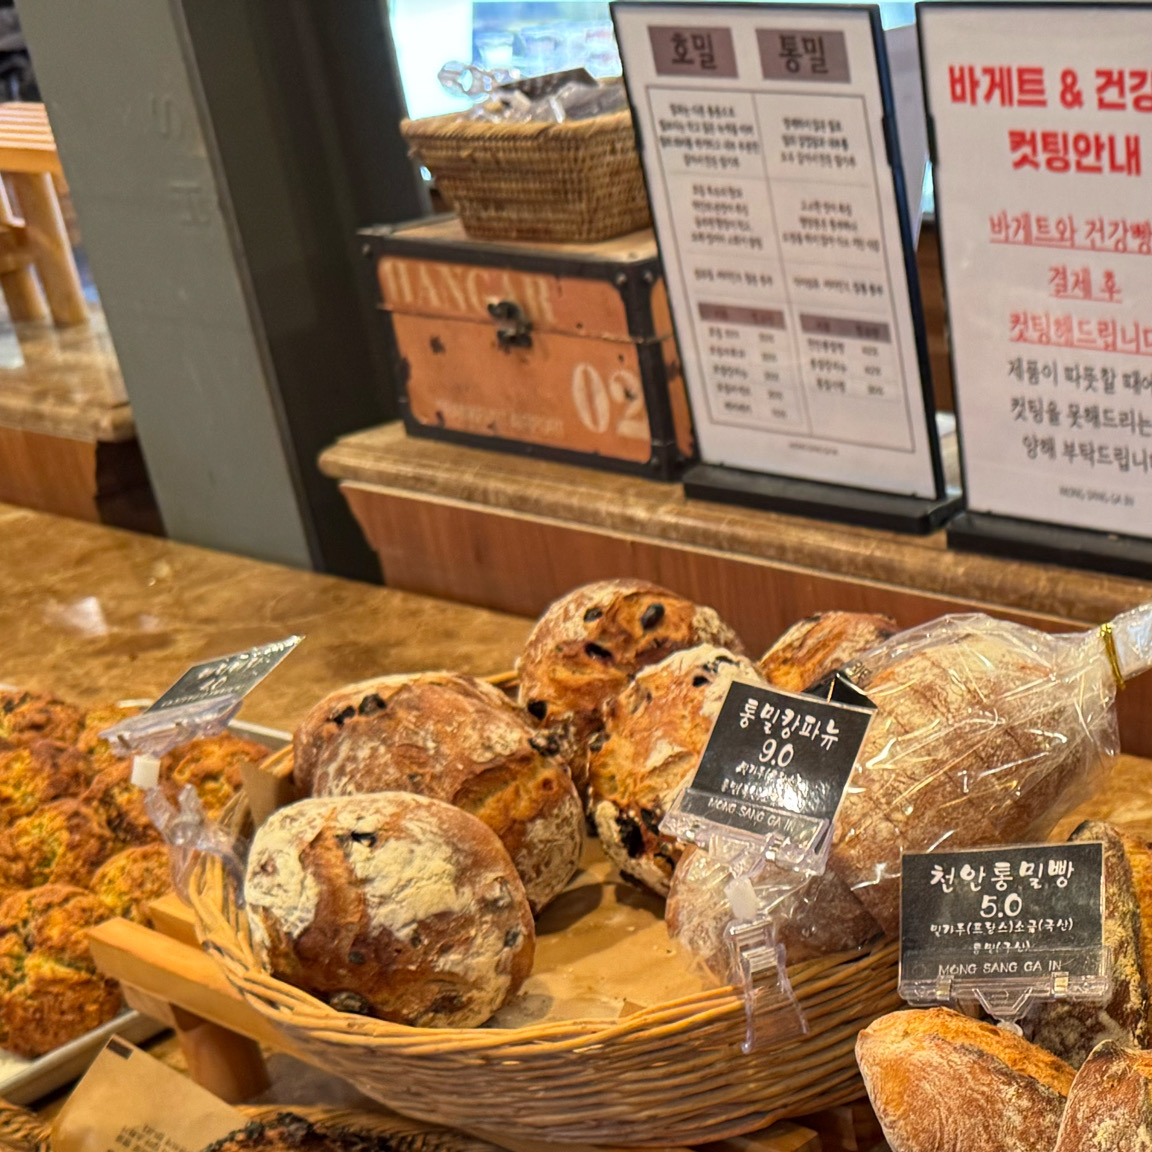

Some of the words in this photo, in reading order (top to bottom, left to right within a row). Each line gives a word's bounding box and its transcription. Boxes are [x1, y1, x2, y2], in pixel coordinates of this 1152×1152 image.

[671, 32, 717, 70] 호밀
[779, 34, 829, 74] 통밀
[948, 64, 1048, 107] 바게트
[1059, 69, 1084, 109] &
[1008, 129, 1142, 177] 컷팅안내
[989, 211, 1076, 246] 바게트와
[1049, 264, 1093, 298] 결제
[1100, 270, 1122, 301] 후
[1008, 356, 1059, 385] 제품이
[1064, 365, 1117, 395] 따뜻할
[571, 363, 649, 439] 02
[1011, 397, 1060, 427] 컷팅을
[1022, 434, 1057, 460] 양해
[758, 738, 795, 767] 9.0
[708, 797, 737, 814] MONG
[739, 807, 765, 822] SANG
[767, 816, 781, 828] GA
[784, 819, 795, 832] IN
[930, 859, 1075, 893] 천안통밀빵
[979, 893, 1022, 918] 5.0
[938, 963, 977, 976] MONG
[983, 961, 1018, 973] SANG
[1023, 960, 1042, 972] GA
[1049, 959, 1062, 971] IN
